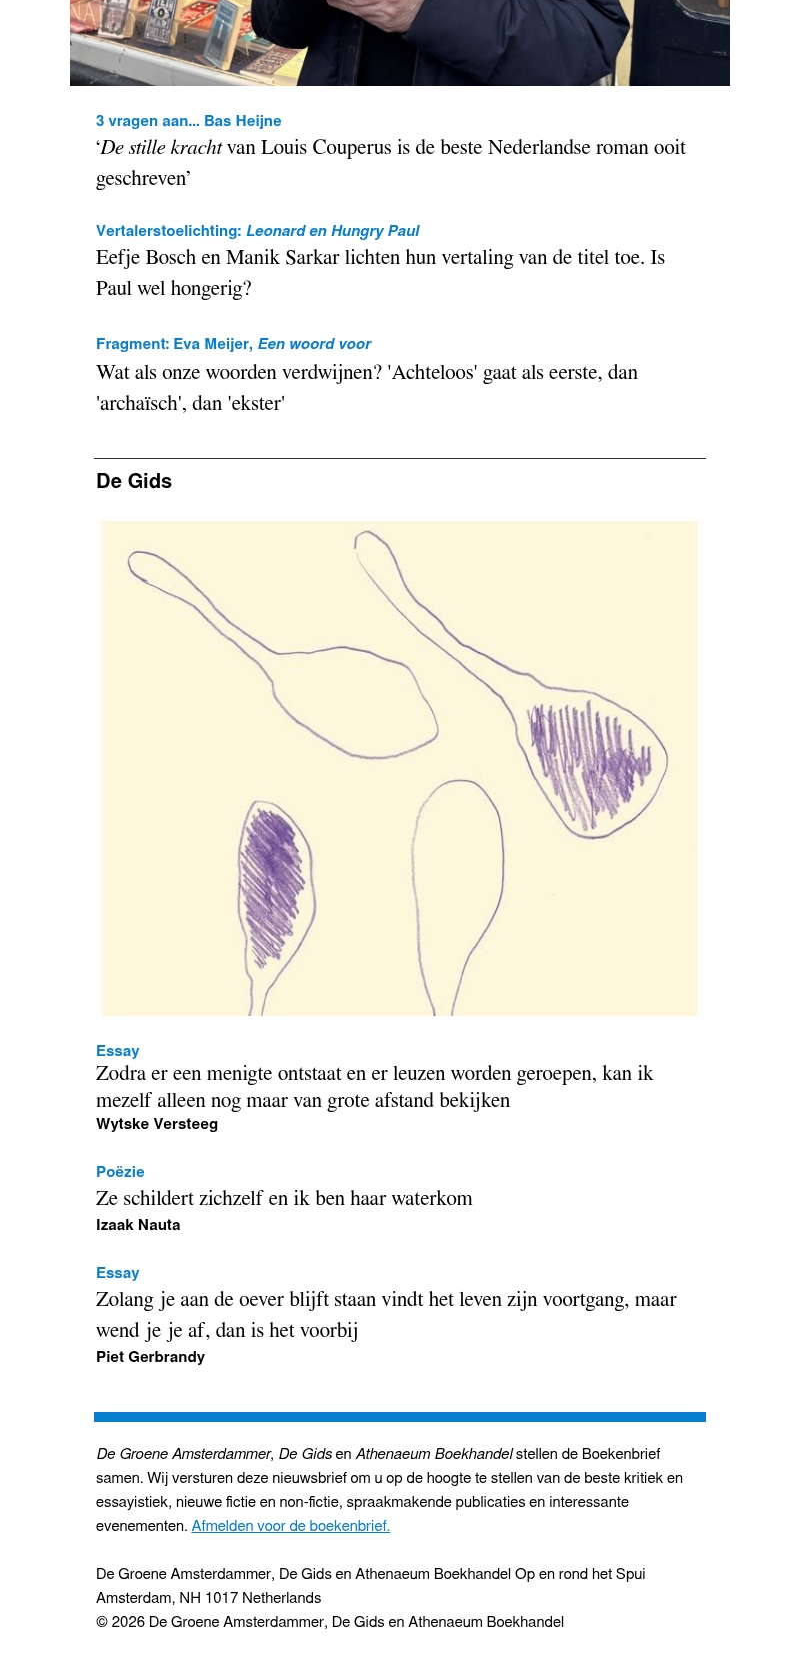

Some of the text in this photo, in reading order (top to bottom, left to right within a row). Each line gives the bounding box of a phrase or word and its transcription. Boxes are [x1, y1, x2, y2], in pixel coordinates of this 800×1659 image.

[96, 115, 281, 129] 3 vragen aan... Bas Heijne
[96, 225, 420, 240] Vertalerstoelichting: Leonard en Hungry Paul
[96, 280, 251, 300] Paul wel hongerig?
[97, 338, 372, 352] Fragment: Eva Meijer, Een woord voor
[193, 395, 222, 410] dan
[97, 473, 172, 489] De Gids
[97, 1045, 139, 1059] Essay
[96, 1118, 217, 1132] Wytske Versteeg
[97, 1166, 144, 1177] Poëzie
[96, 1190, 472, 1205] Ze schildert zichzelf en ik ben haar waterkom
[97, 1219, 180, 1230] Izaak Nauta
[97, 1267, 139, 1281] Essay
[97, 1351, 205, 1365] Piet Gerbrandy
[96, 1520, 389, 1531] evenementen. Afmelden voor de boekenbrief.
[96, 1592, 321, 1605] Amsterdam, NH 1017 Netherlands
